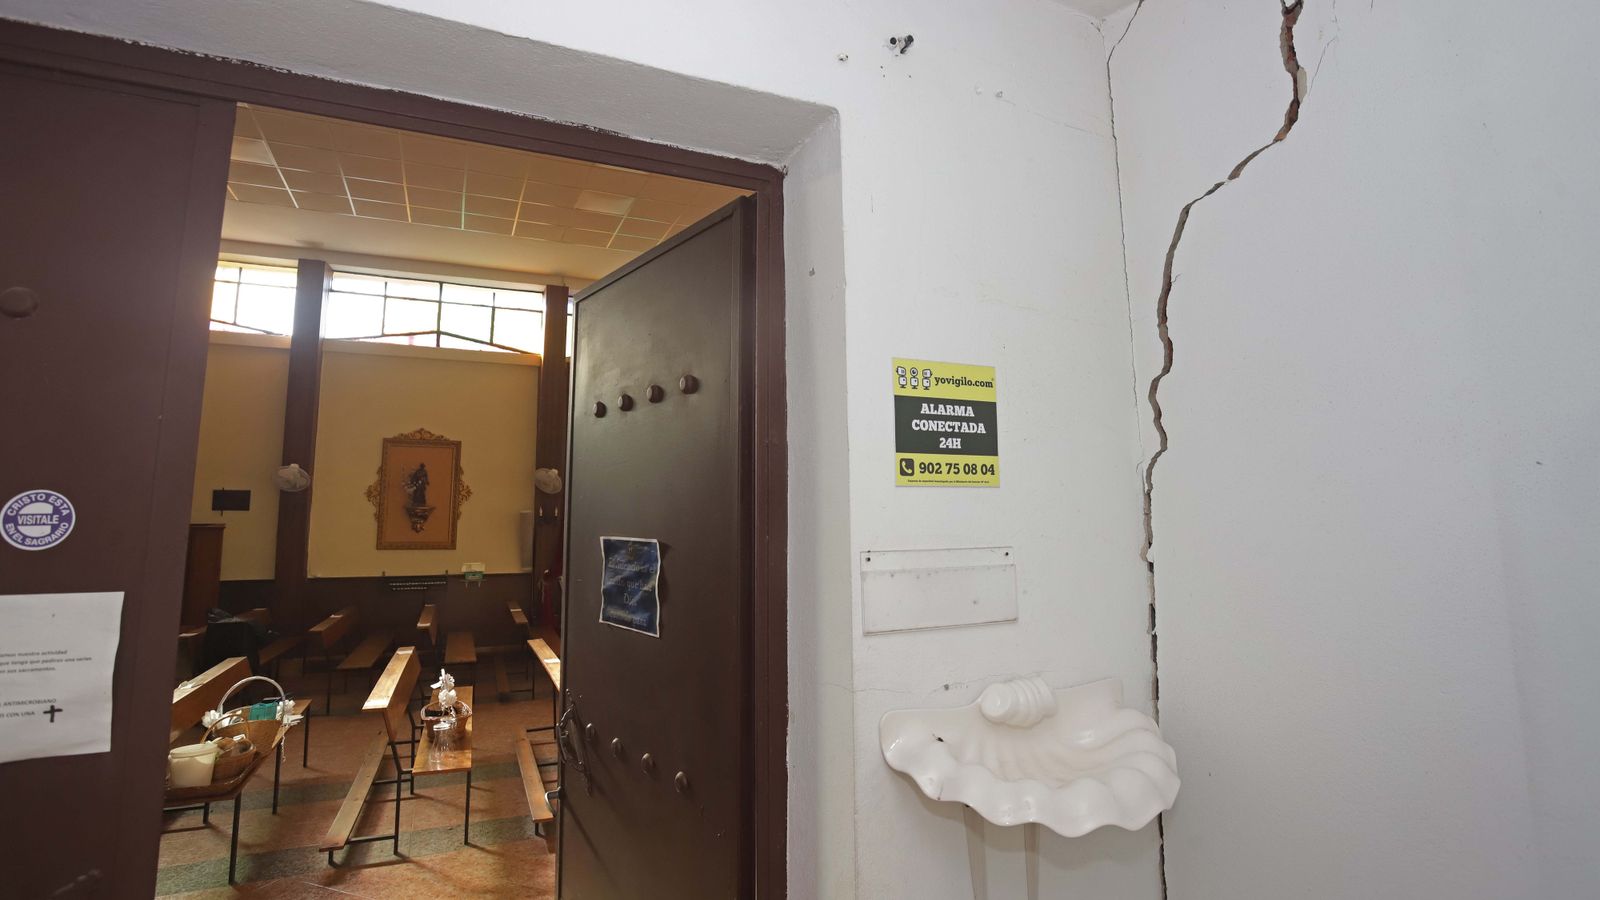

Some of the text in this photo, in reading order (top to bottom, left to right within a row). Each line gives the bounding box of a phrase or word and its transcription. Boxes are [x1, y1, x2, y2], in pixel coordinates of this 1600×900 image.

[934, 376, 993, 388] yovigilo.com
[920, 403, 975, 417] ALARMA
[911, 419, 986, 434] CONECTADA
[939, 437, 962, 449] 24H
[919, 462, 995, 476] 902 75 08 04
[7, 493, 71, 516] CRISTO ESTA
[17, 514, 60, 525] VISITALE
[5, 522, 69, 546] EN EL SAGRARIO
